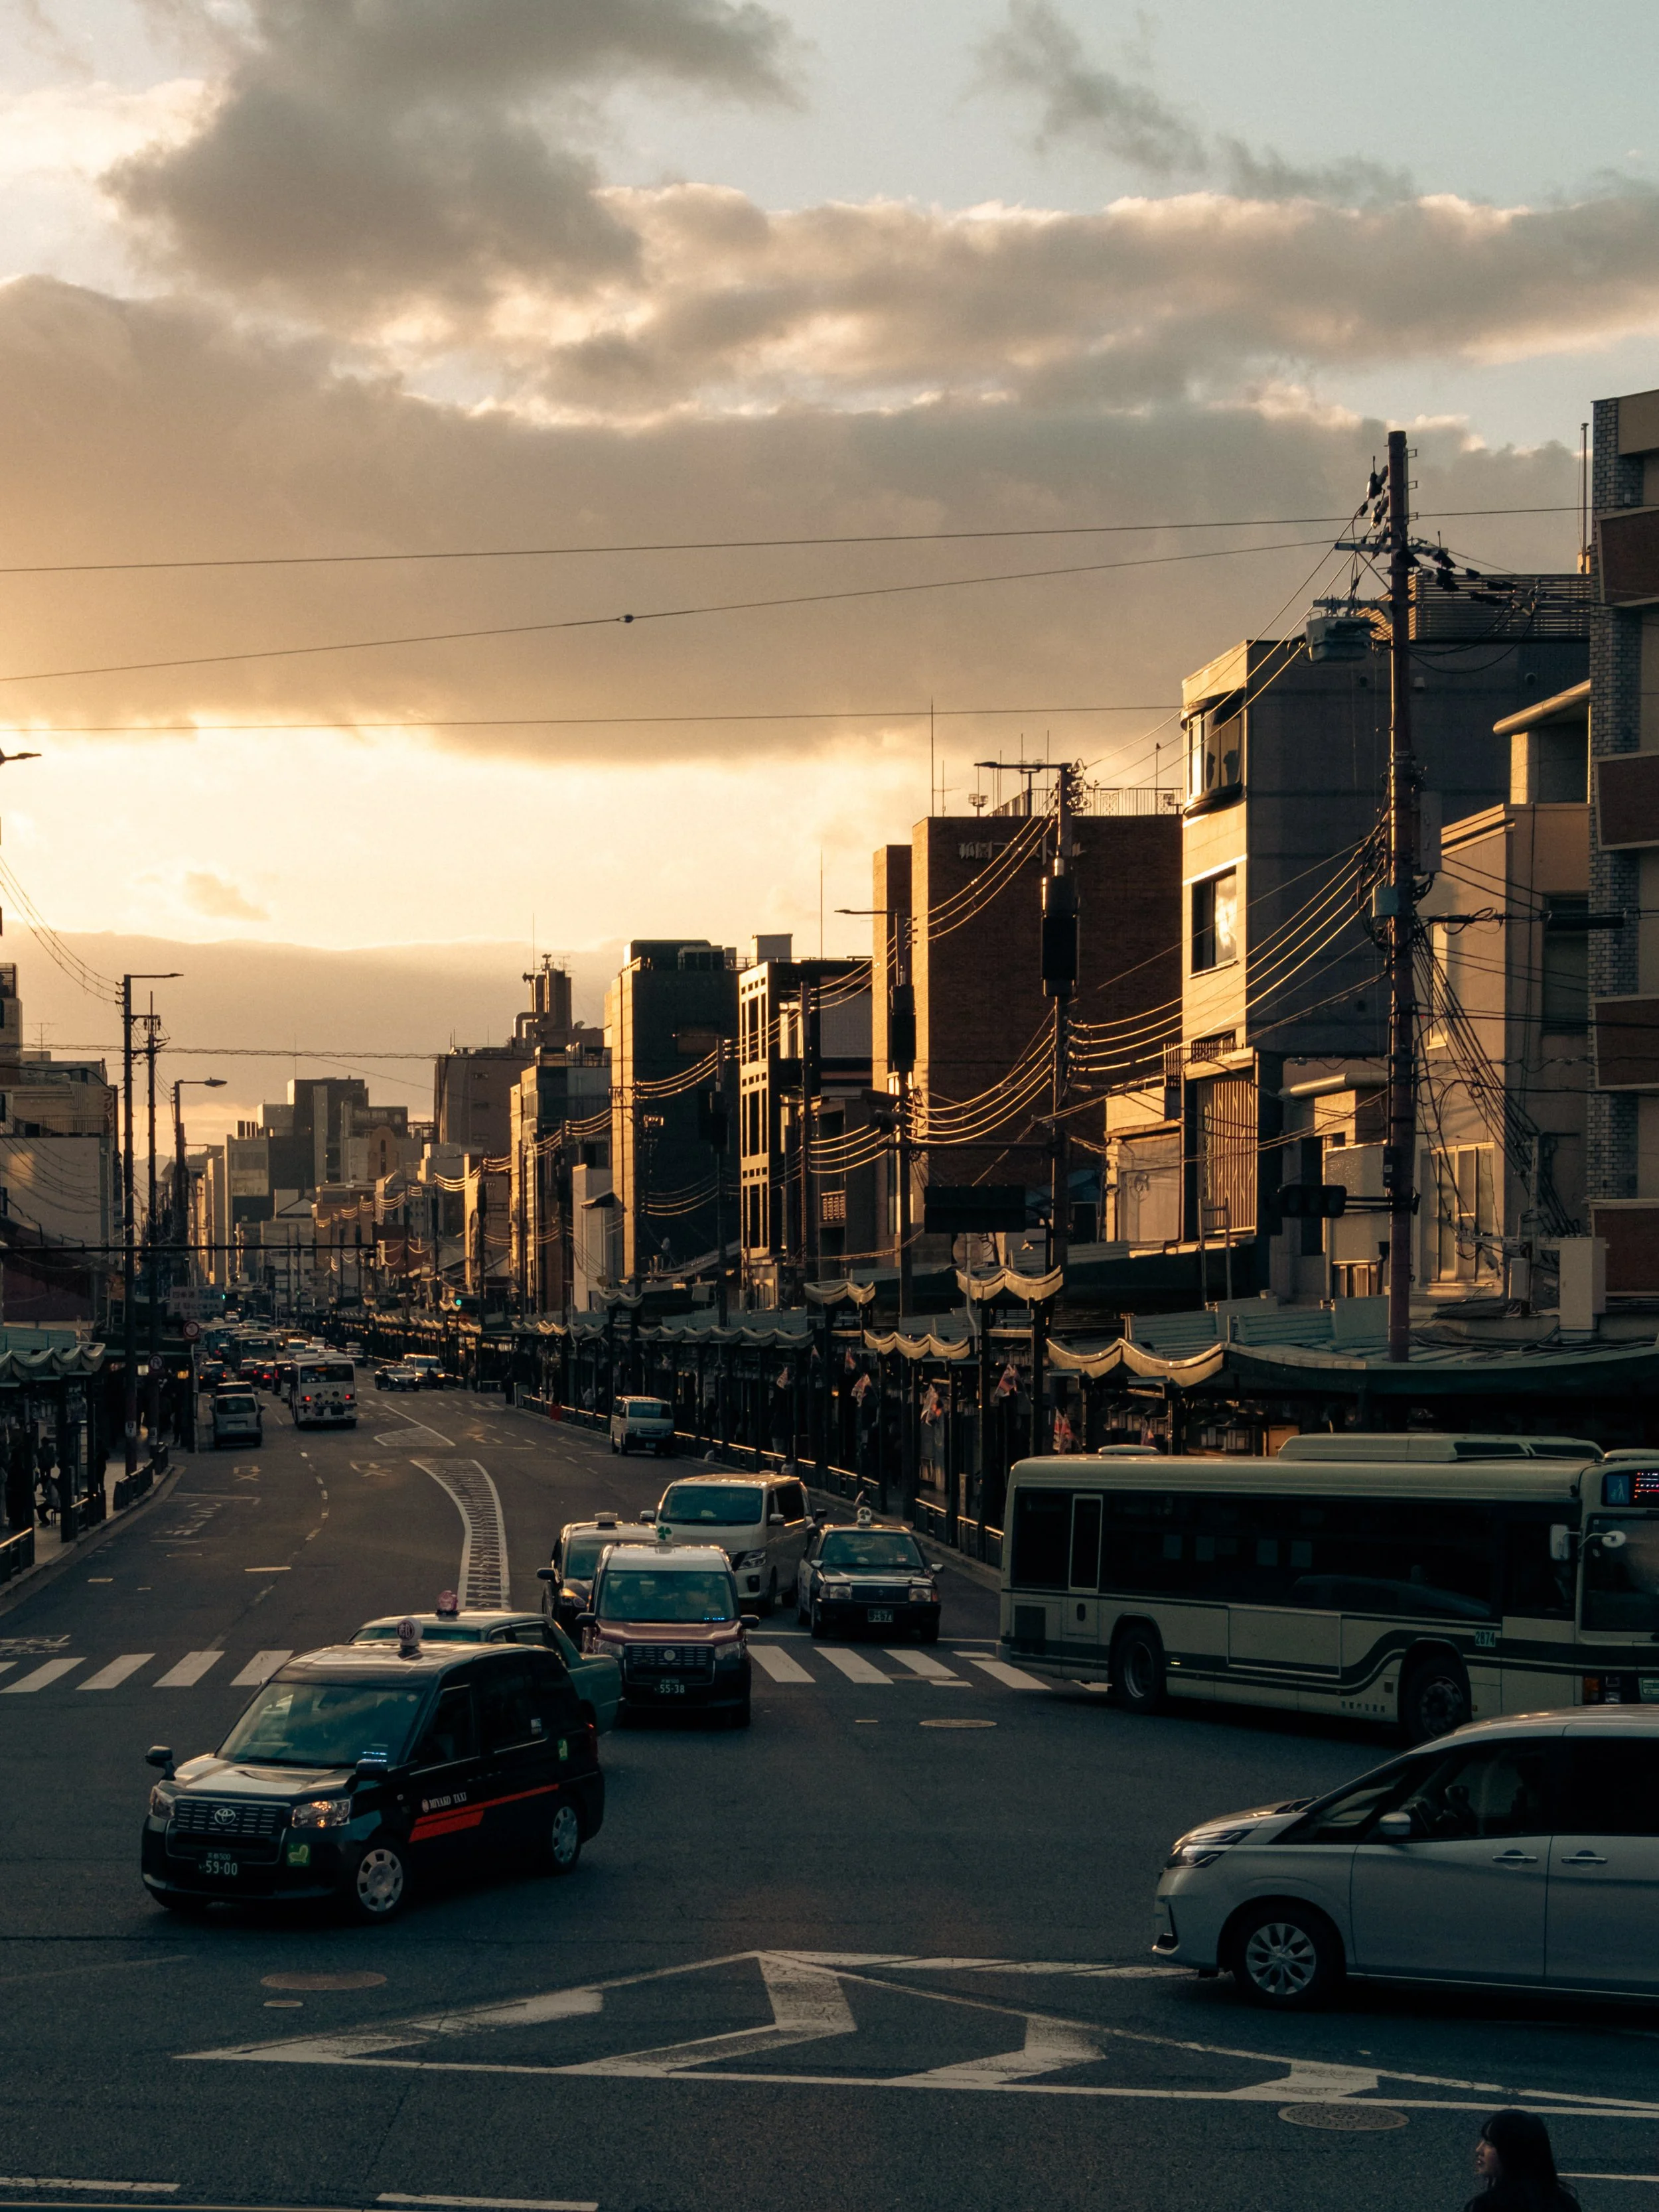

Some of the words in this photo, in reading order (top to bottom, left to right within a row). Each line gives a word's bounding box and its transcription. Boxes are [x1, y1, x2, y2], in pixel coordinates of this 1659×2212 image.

[1475, 1631, 1494, 1646] 2874
[660, 1684, 685, 1694] 55-38
[453, 1791, 467, 1804] TAXI
[206, 1860, 238, 1876] 59-00
